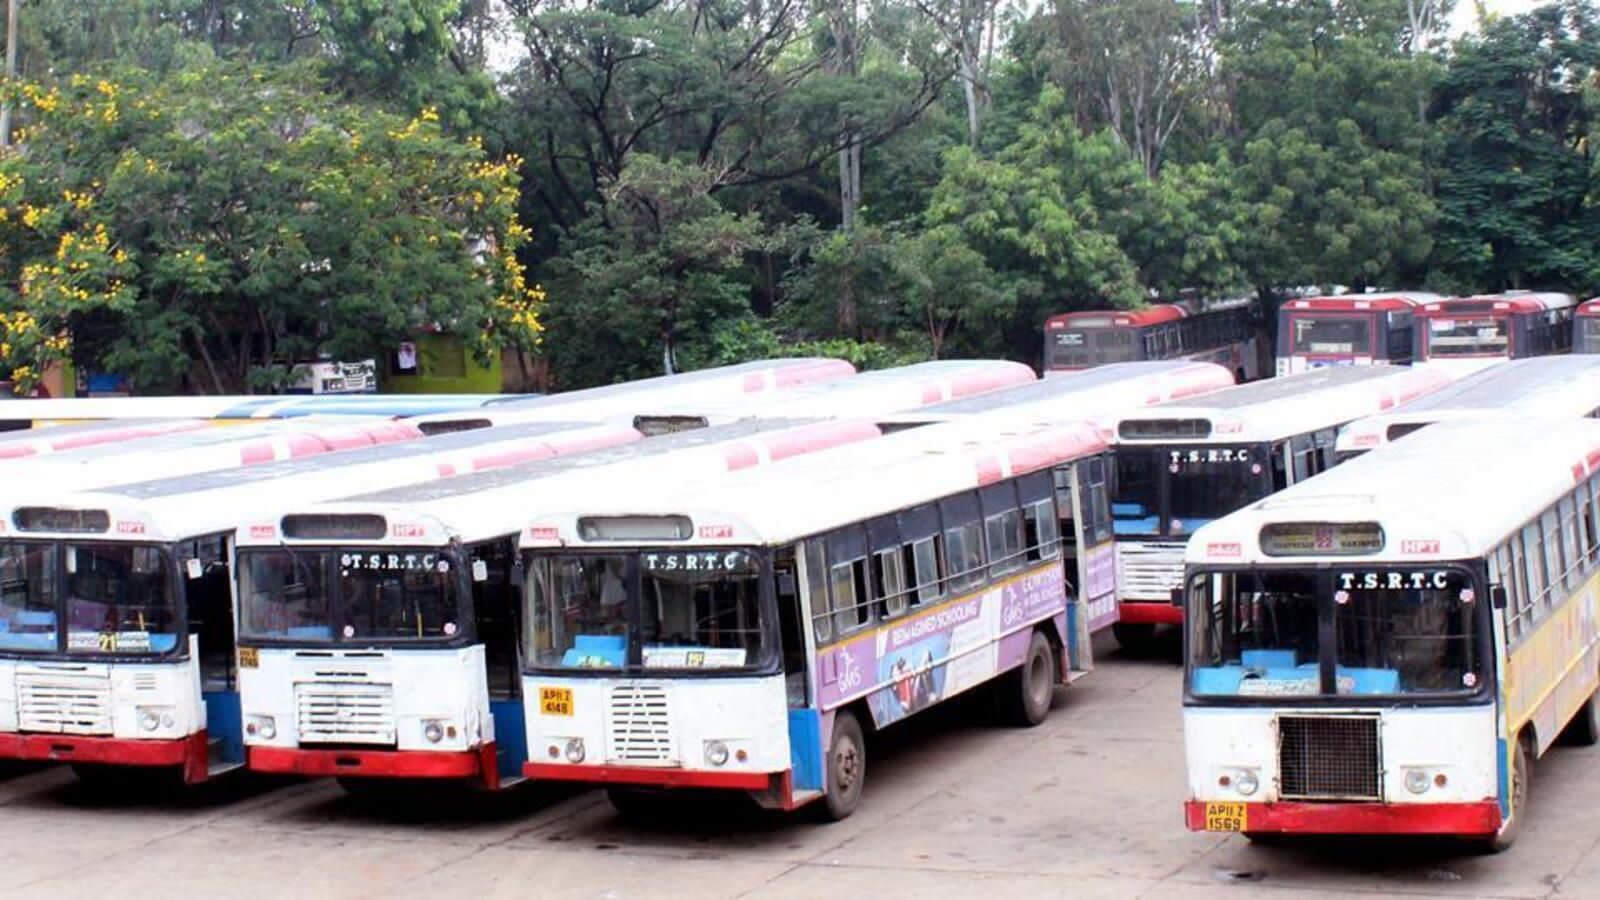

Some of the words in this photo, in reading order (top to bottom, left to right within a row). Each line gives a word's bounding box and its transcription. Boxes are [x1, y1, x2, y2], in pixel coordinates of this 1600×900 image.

[1171, 449, 1248, 463] T.S.R.T.C
[1401, 540, 1440, 553] HPT
[351, 554, 434, 569] T.S.R.T.C
[647, 552, 739, 570] T.S.R.T.C
[1341, 571, 1447, 589] T.S.R.T.C
[1209, 817, 1241, 831] 1569
